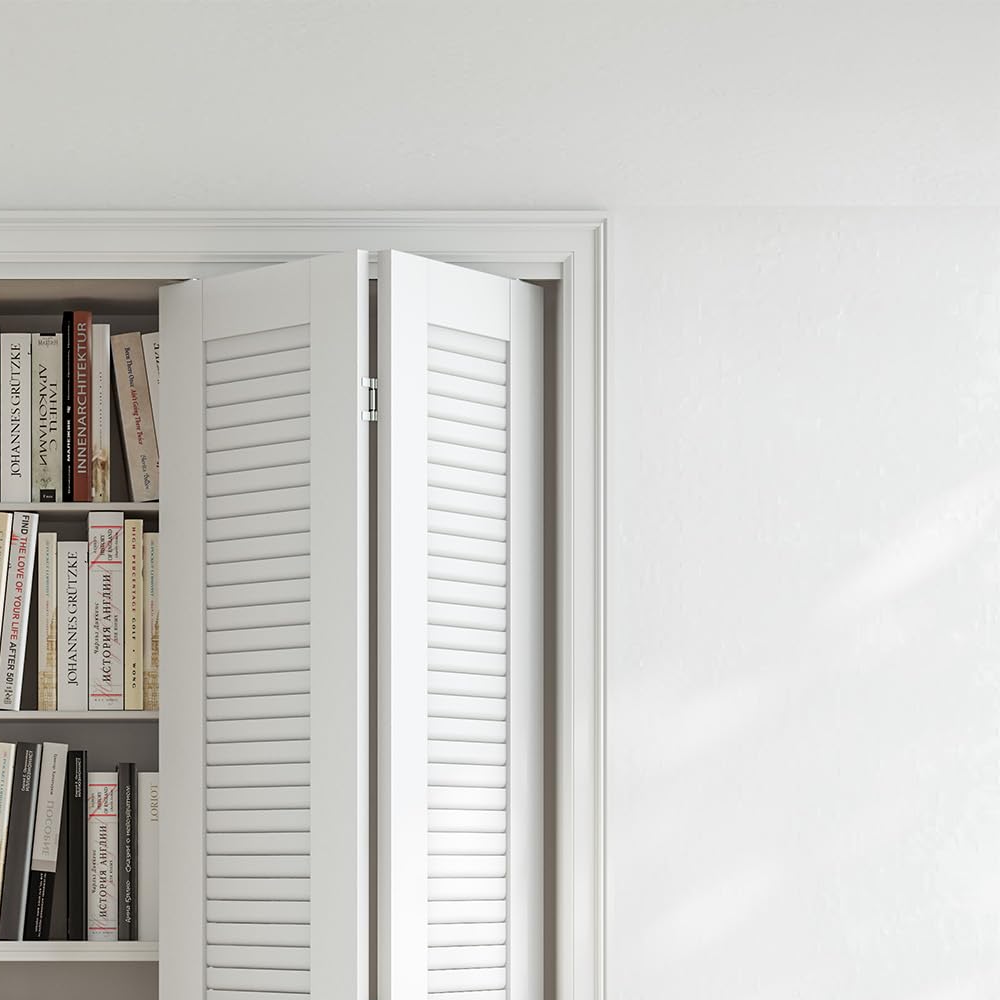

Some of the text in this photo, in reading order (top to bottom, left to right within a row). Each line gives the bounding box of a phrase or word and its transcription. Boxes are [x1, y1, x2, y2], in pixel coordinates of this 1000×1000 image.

[8, 343, 21, 477] JOHANNES GRÜTZKE
[77, 322, 87, 473] INNENARCHITEKTUR
[6, 515, 30, 685] FIND THE LOVE OF YOUR LIFE AFTER 50!
[66, 552, 78, 686] JOHANNES GRÜTZKE
[102, 574, 111, 681] ИСТОРИЯ АНГЛИИ
[42, 800, 54, 855] ПОСОБИЕ
[149, 783, 158, 822] LORIOT
[99, 825, 107, 917] ИСТОРИЯ АНГЛИИ
[124, 845, 132, 872] Сказки
[124, 905, 132, 922] Анна
